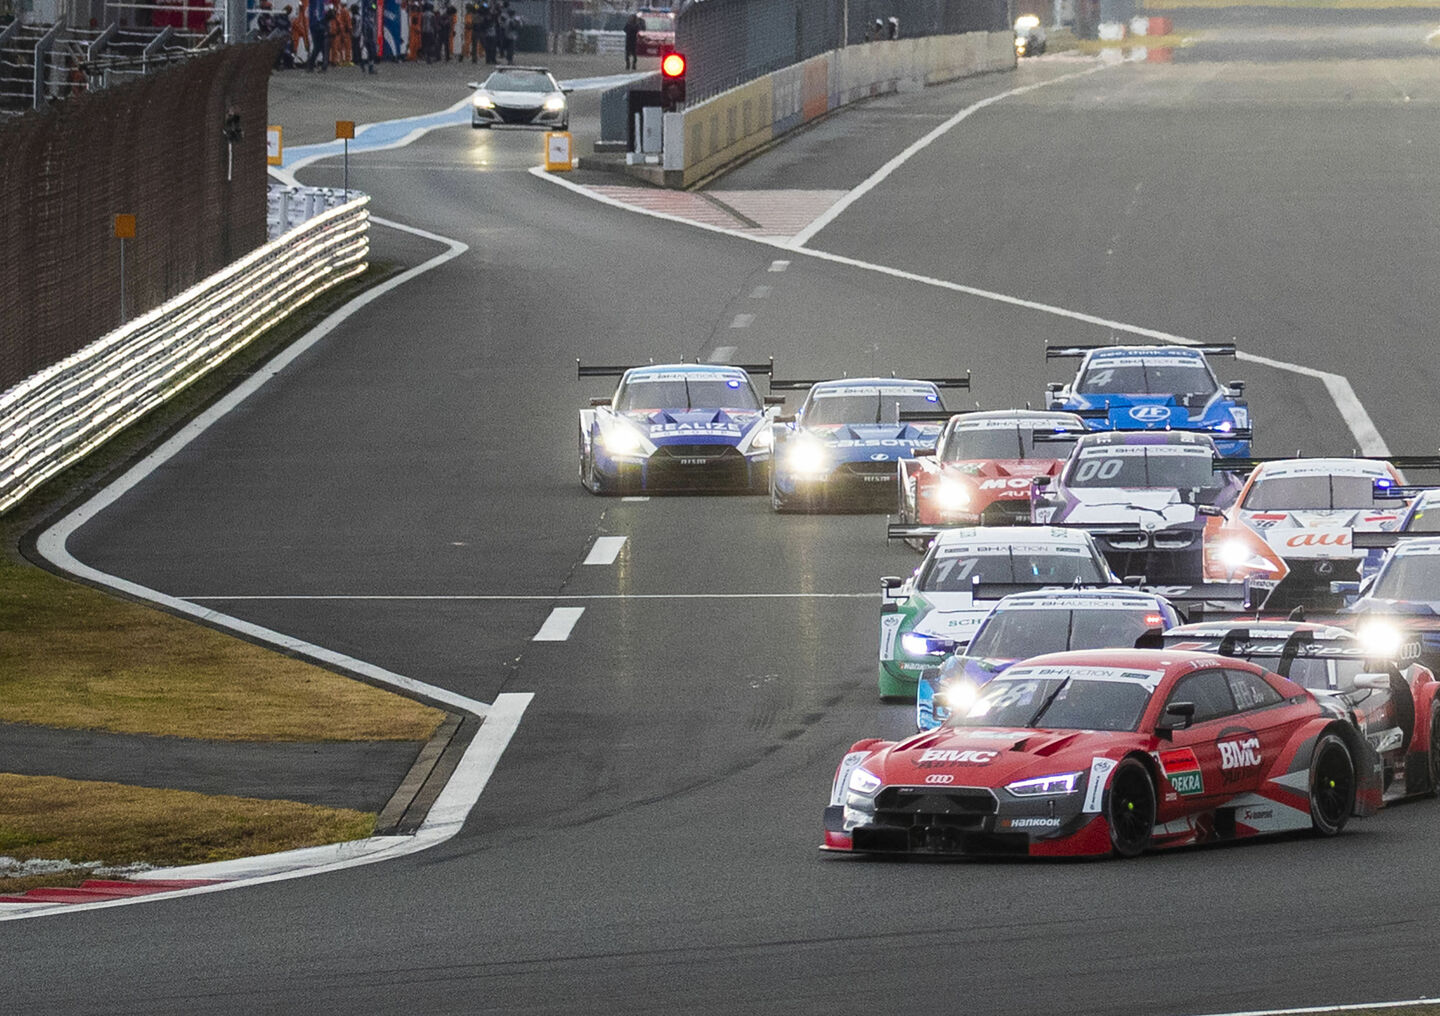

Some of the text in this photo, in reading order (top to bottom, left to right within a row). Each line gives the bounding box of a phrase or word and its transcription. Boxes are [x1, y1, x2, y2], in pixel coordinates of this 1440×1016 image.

[1087, 369, 1115, 386] 4
[1134, 406, 1165, 418] ZF
[650, 422, 740, 433] REALIZE
[1076, 459, 1124, 482] 00
[1286, 533, 1353, 547] au
[936, 558, 979, 583] 11
[917, 749, 999, 763] BMC
[1218, 737, 1262, 770] BMC
[1171, 774, 1201, 792] DEKRA
[1010, 817, 1061, 828] Hankook
